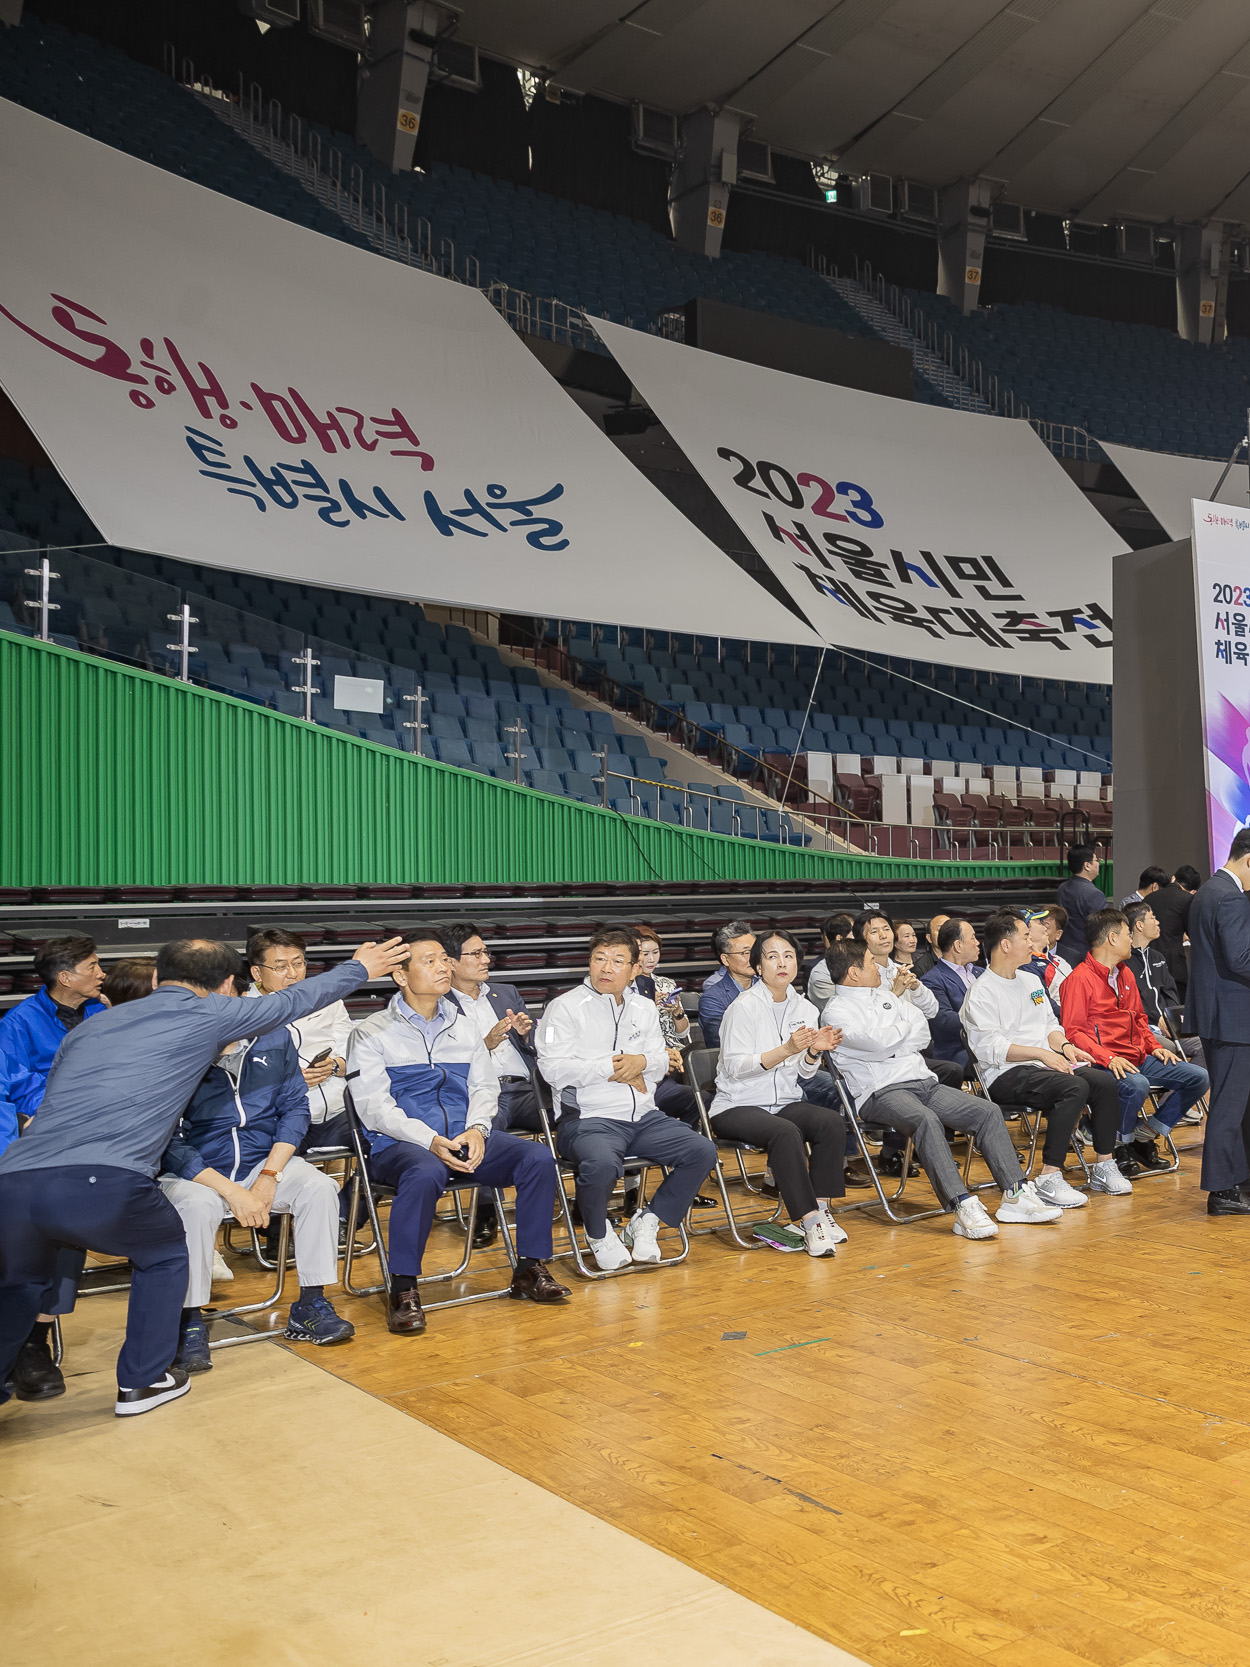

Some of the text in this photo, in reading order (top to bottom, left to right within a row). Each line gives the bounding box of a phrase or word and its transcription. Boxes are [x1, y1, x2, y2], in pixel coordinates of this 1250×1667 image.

[401, 114, 416, 130] 36
[710, 211, 723, 224] 36
[967, 270, 979, 280] 37
[1202, 304, 1213, 314] 37
[185, 425, 571, 553] 특별시 서울
[716, 446, 885, 530] 2023
[761, 509, 1027, 601] 서울시민
[791, 560, 1114, 651] 체육대축전
